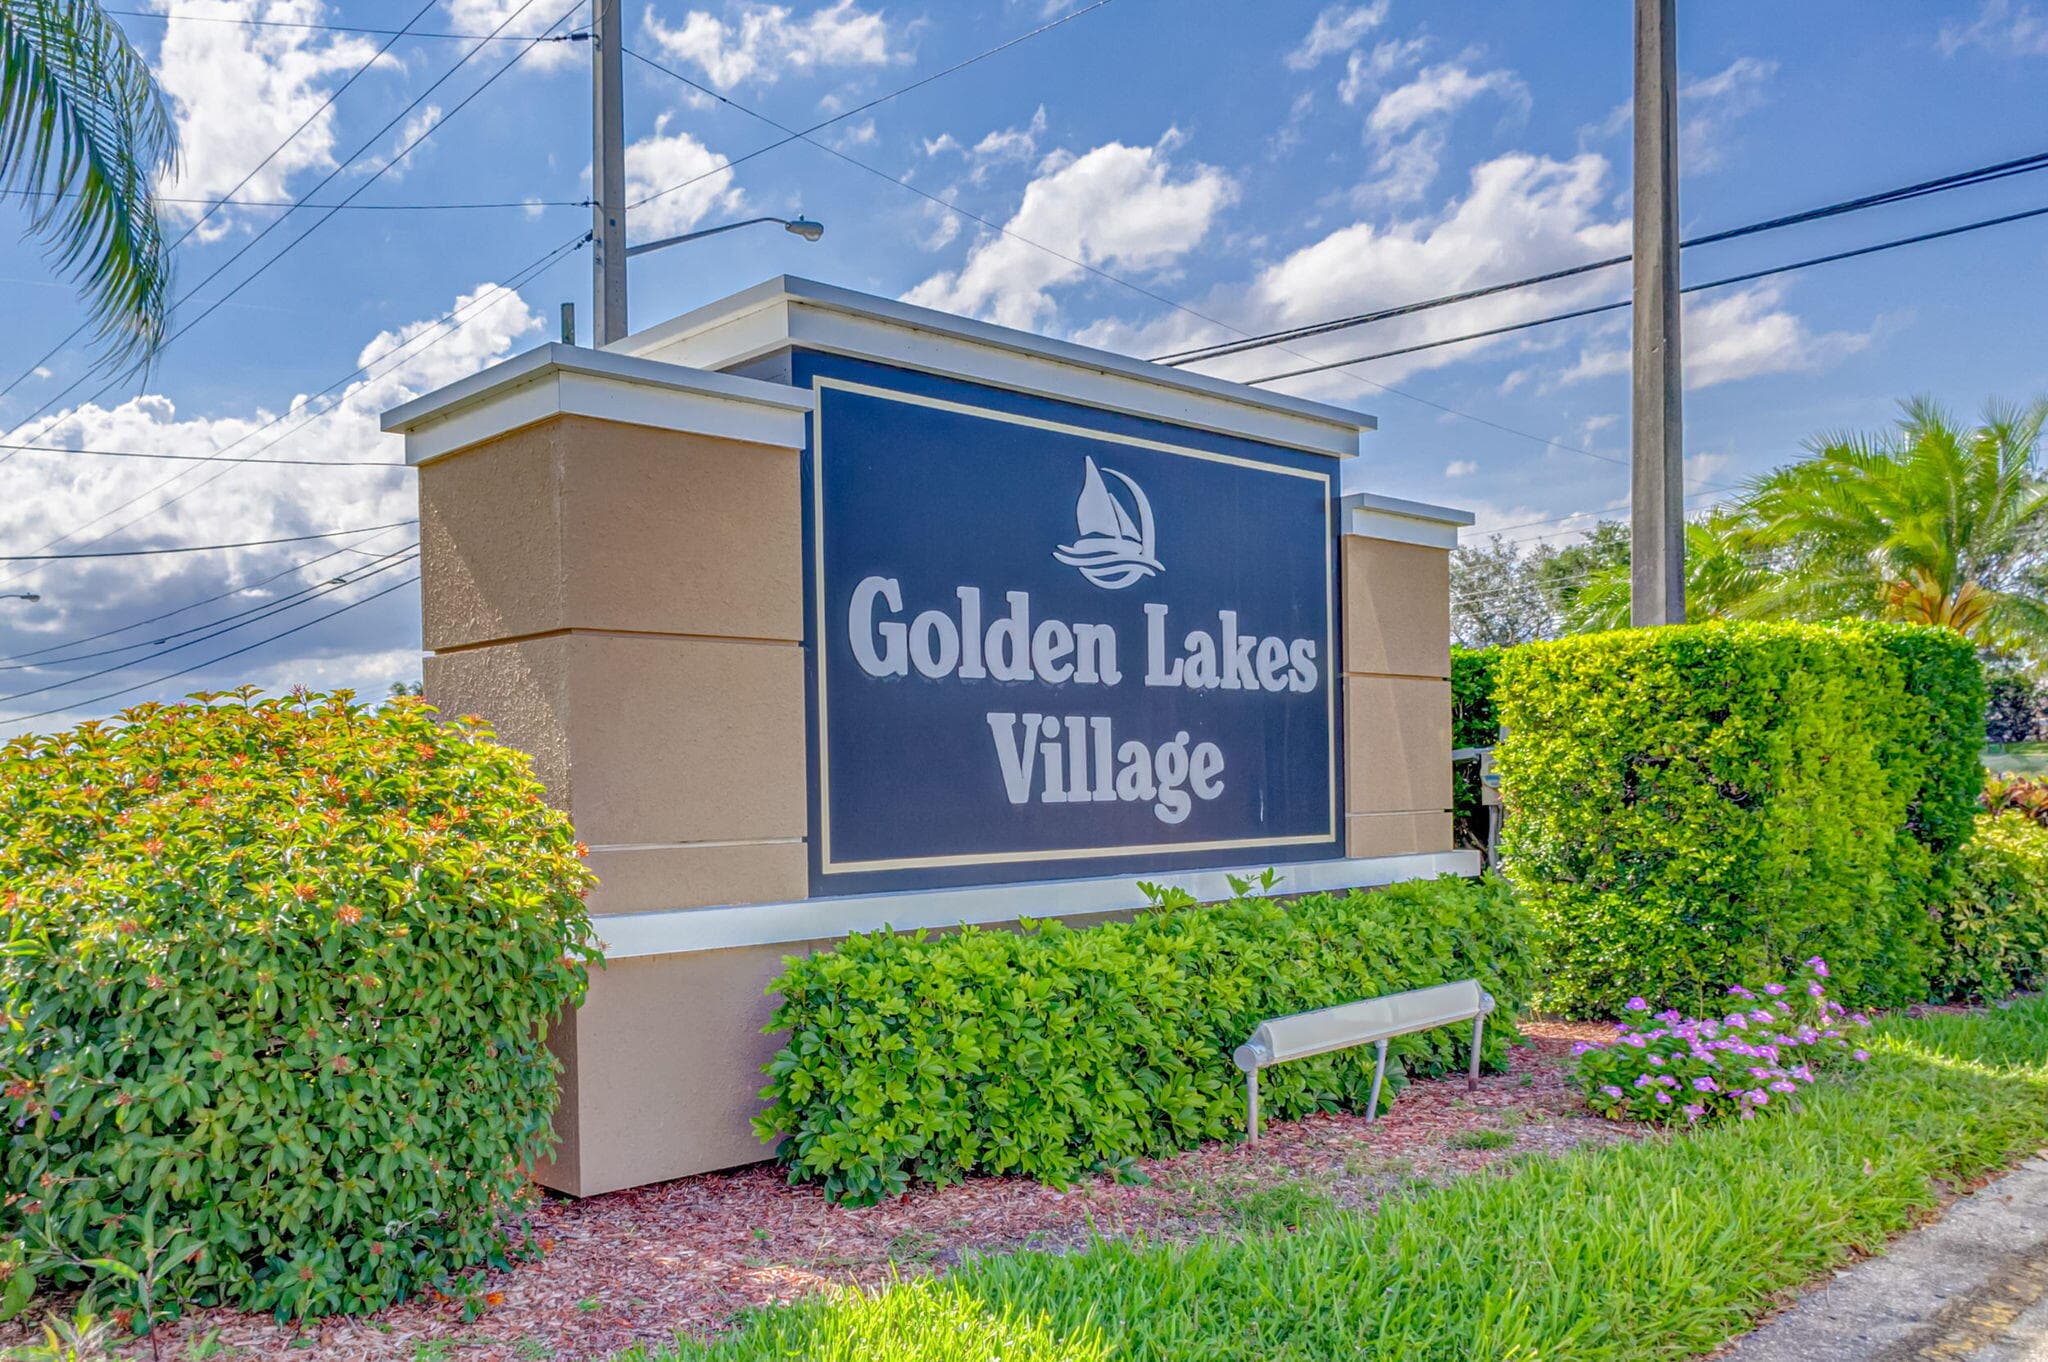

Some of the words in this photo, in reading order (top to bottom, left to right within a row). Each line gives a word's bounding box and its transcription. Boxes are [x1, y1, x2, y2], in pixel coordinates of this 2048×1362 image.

[848, 576, 1123, 686] Golden
[1143, 603, 1319, 693] Lakes
[986, 712, 1225, 825] Village
